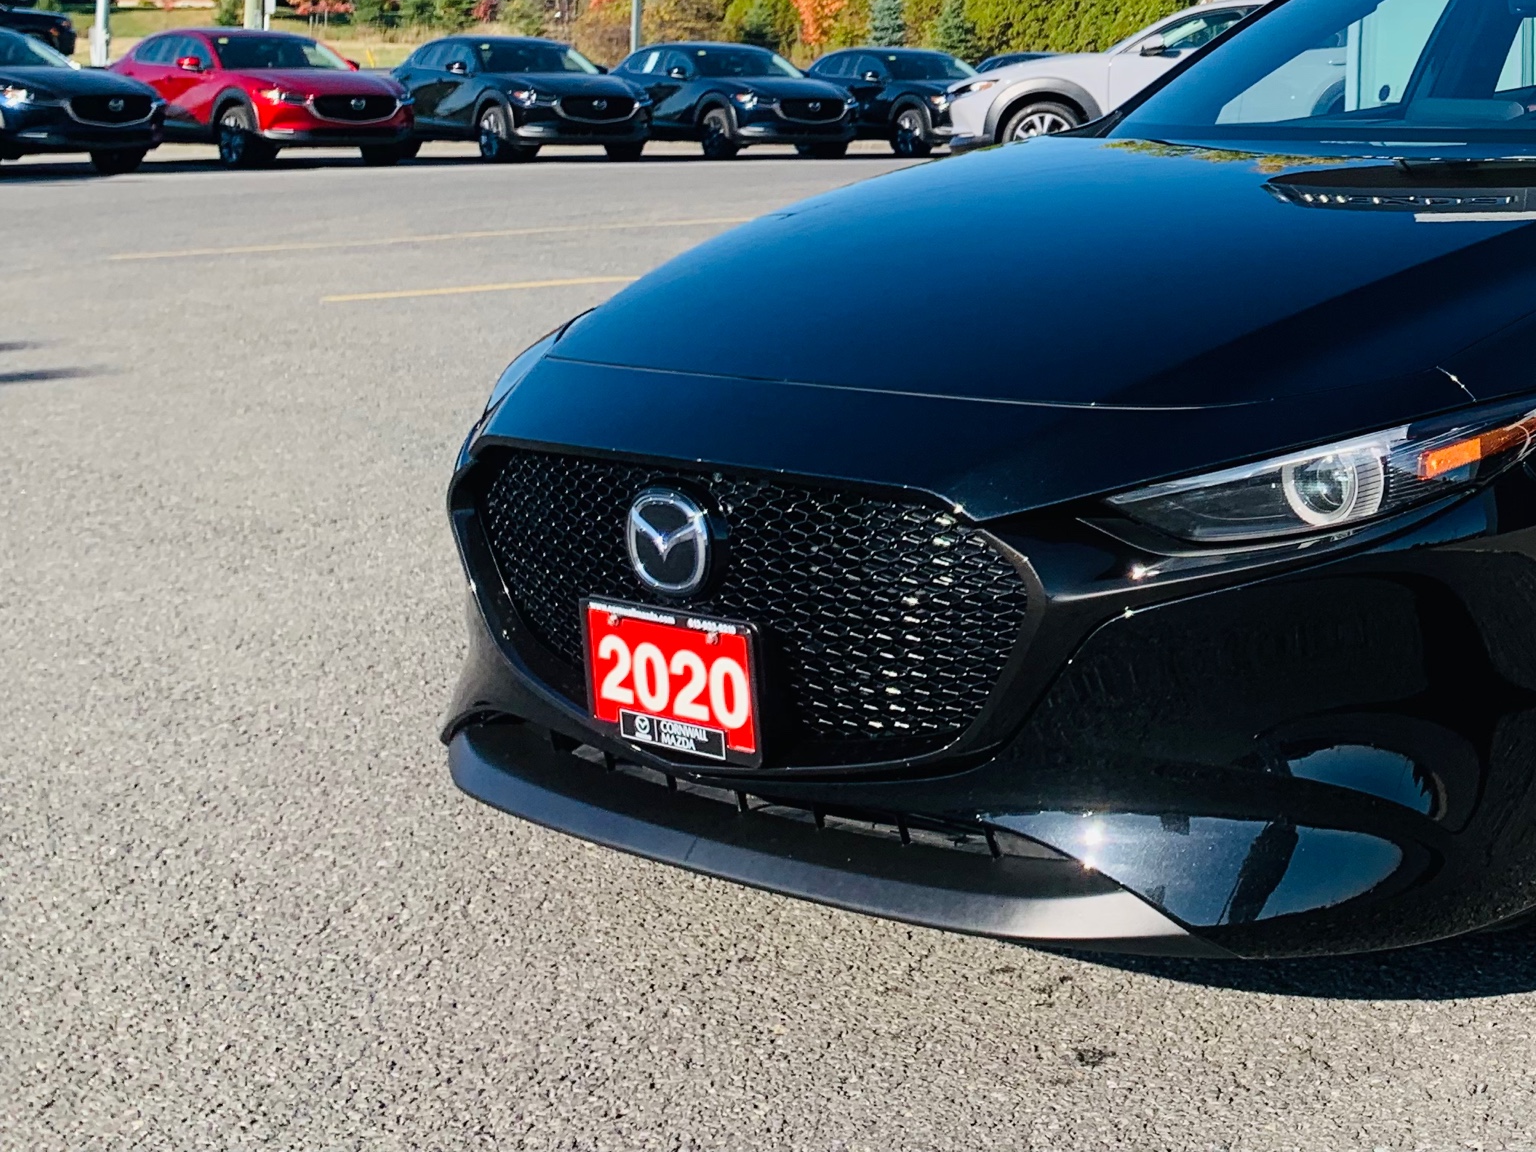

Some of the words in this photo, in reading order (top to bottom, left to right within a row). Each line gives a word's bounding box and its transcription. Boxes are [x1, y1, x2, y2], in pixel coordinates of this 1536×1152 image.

[598, 634, 749, 729] 2020
[660, 721, 709, 742] CORNWALL
[662, 733, 697, 751] MAZDA
